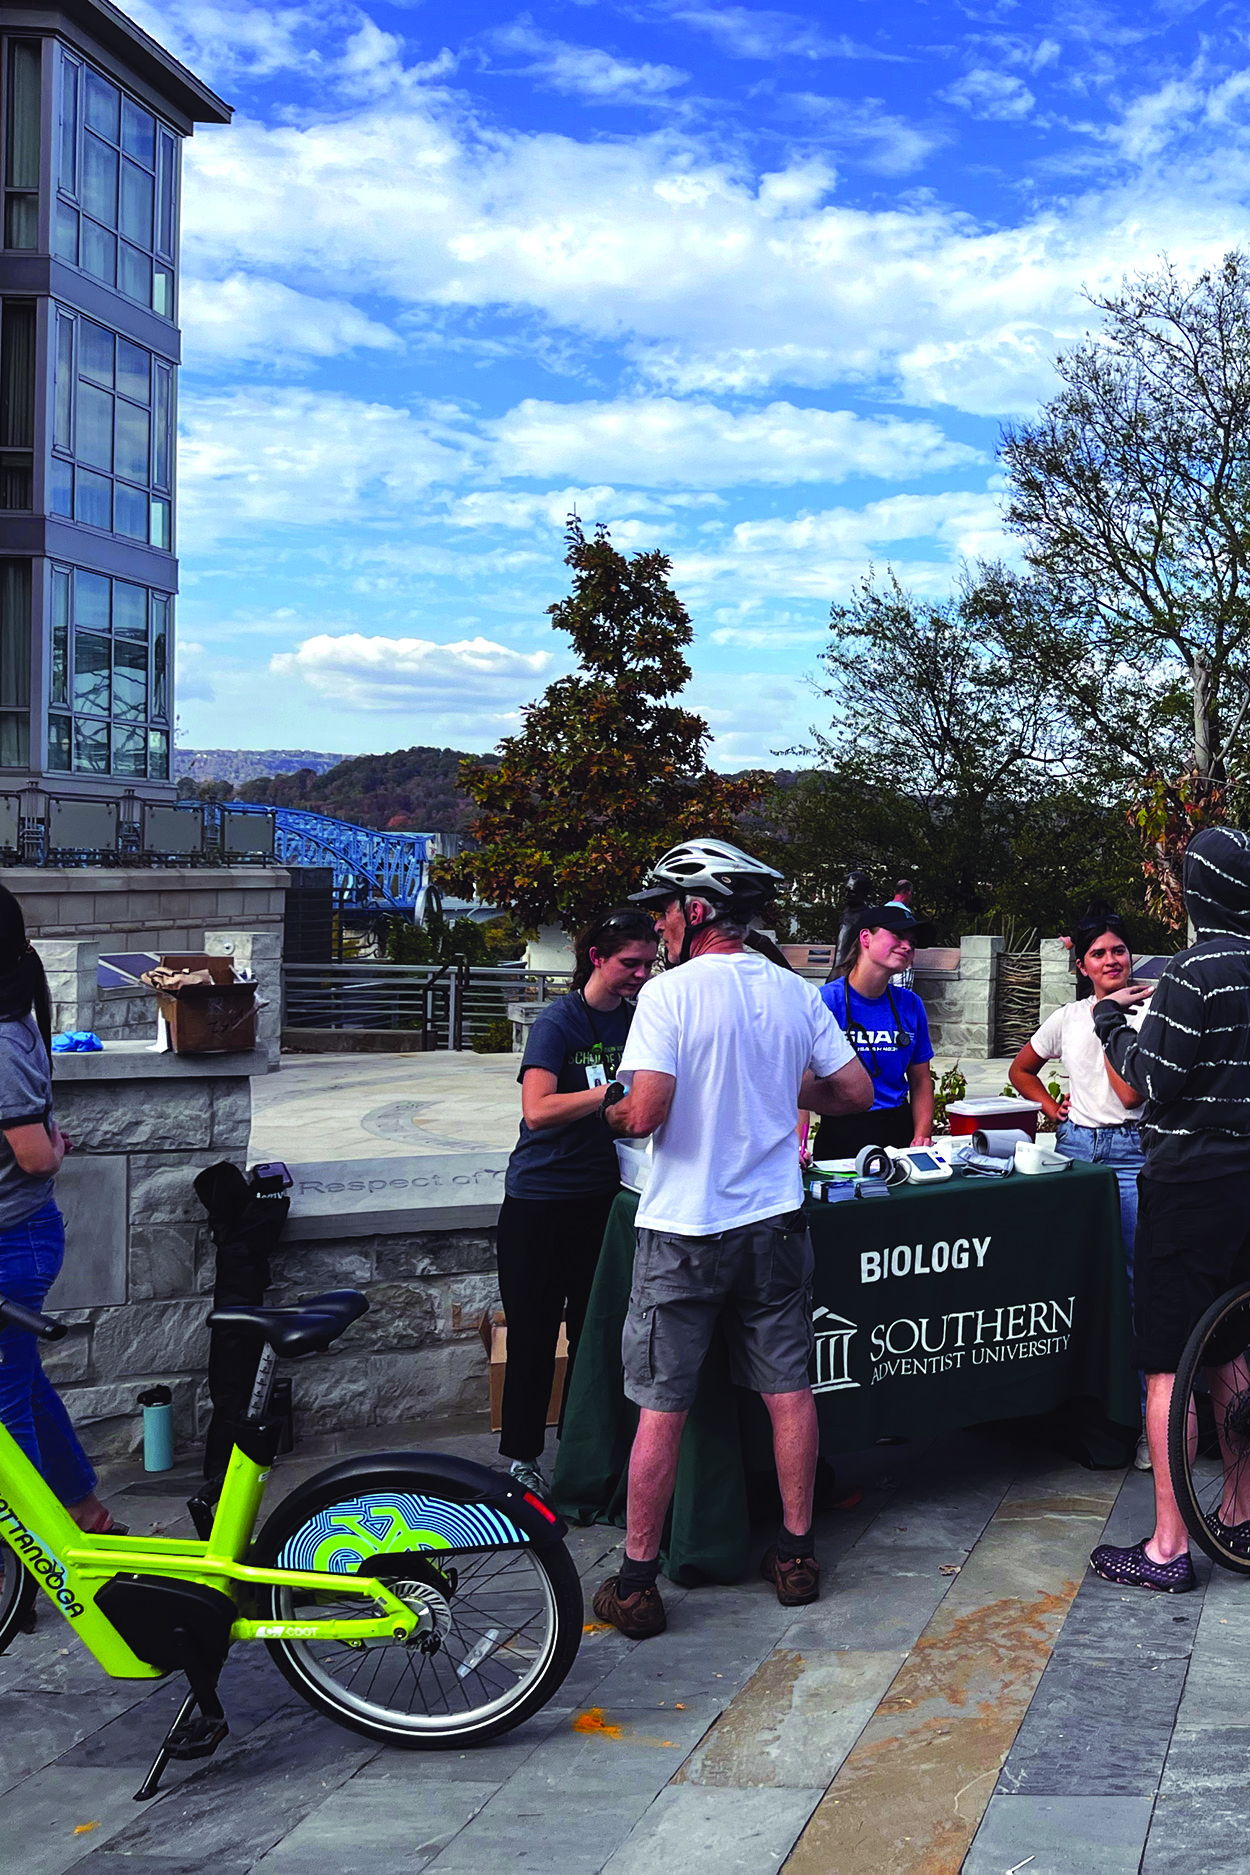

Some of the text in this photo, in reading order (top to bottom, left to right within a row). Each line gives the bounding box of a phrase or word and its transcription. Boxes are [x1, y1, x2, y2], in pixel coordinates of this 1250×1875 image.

[298, 1174, 443, 1196] Respect
[451, 1171, 485, 1186] of
[860, 1236, 992, 1284] BIOLOGY
[869, 1296, 1076, 1362] SOUTHERN
[870, 1334, 1072, 1386] ADVENTIST UNIVERSITY
[286, 1626, 319, 1637] CDOT
